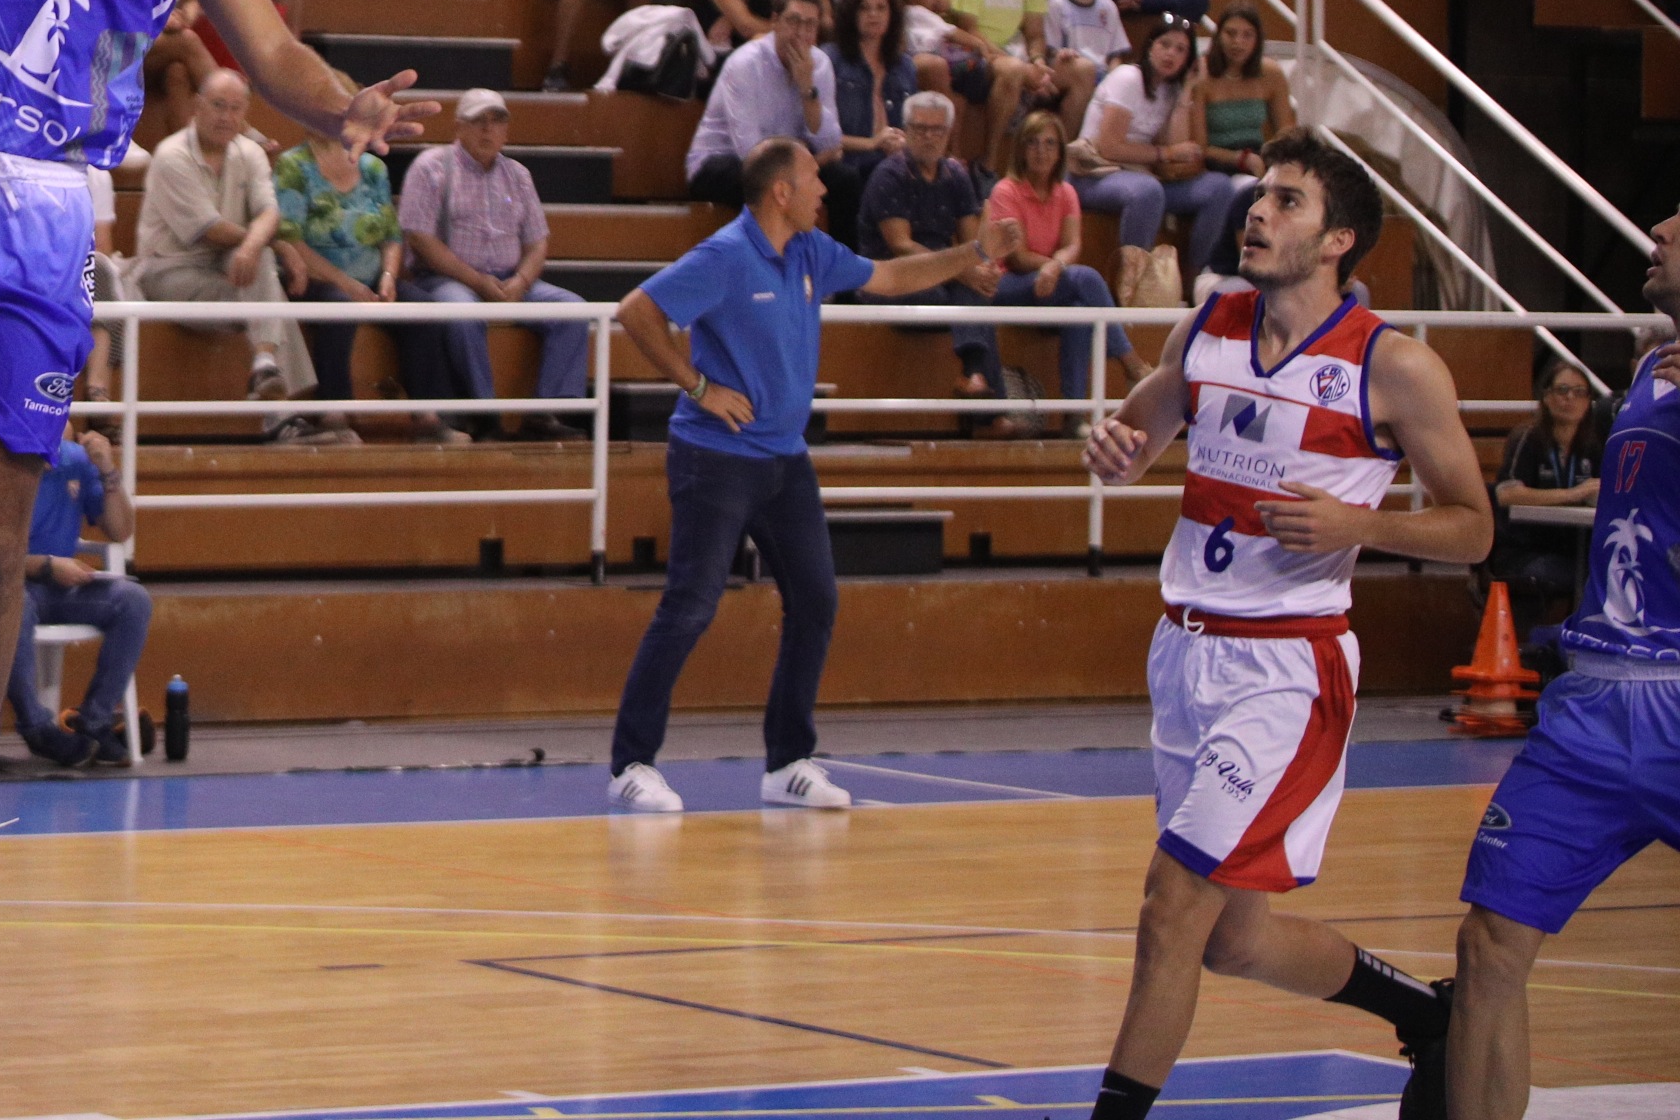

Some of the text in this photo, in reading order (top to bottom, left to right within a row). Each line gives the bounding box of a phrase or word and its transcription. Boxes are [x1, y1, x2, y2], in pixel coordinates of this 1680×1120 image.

[24, 398, 63, 416] Tarraco
[1196, 445, 1286, 479] NUTRION
[1197, 464, 1273, 489] INTERNACIONAL
[1615, 440, 1647, 494] 17
[1203, 515, 1235, 573] 6
[1477, 831, 1508, 848] Center
